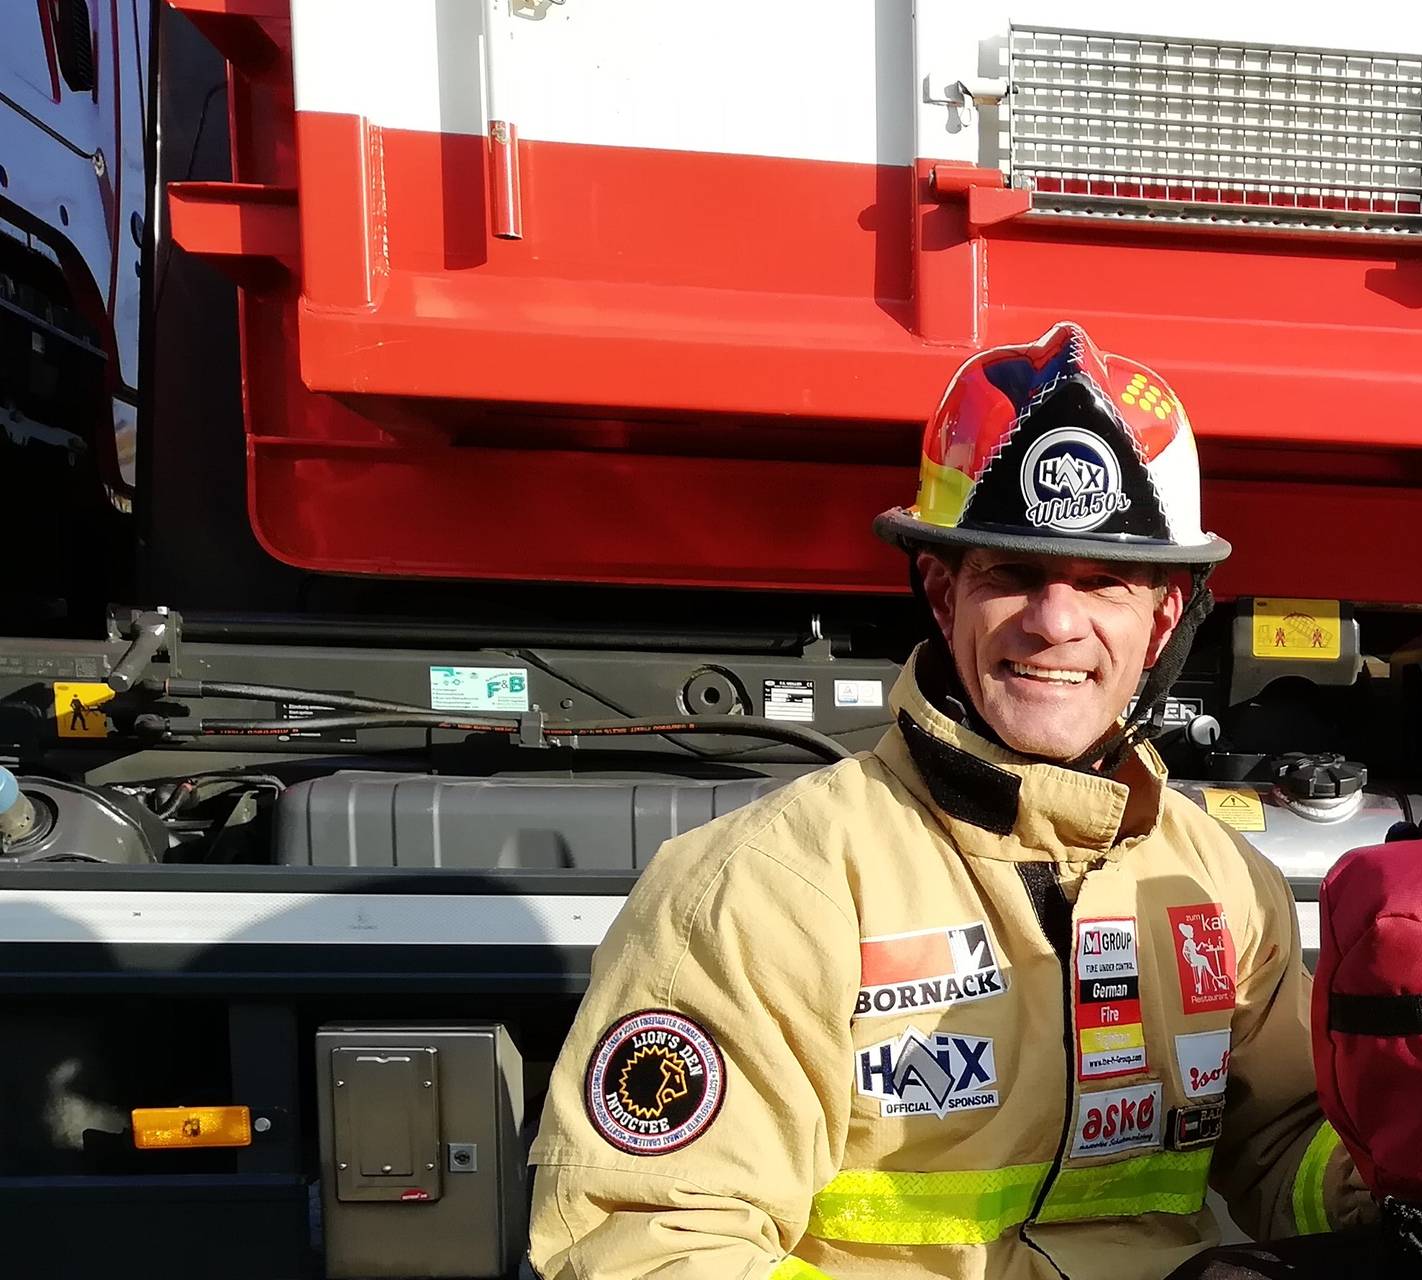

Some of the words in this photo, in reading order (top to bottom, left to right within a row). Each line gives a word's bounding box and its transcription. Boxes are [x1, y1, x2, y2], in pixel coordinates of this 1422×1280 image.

[1026, 496, 1087, 526] Wild
[1102, 932, 1132, 951] GROUP
[853, 969, 1001, 1014] BORNACK
[1093, 982, 1128, 998] German
[1101, 1006, 1119, 1023] Fire
[632, 1031, 680, 1049] LION'S
[679, 1045, 703, 1076] DEN
[606, 1091, 671, 1134] INDUCTEE
[886, 1101, 932, 1114] OFFICIAL
[948, 1094, 995, 1108] SPONSOR
